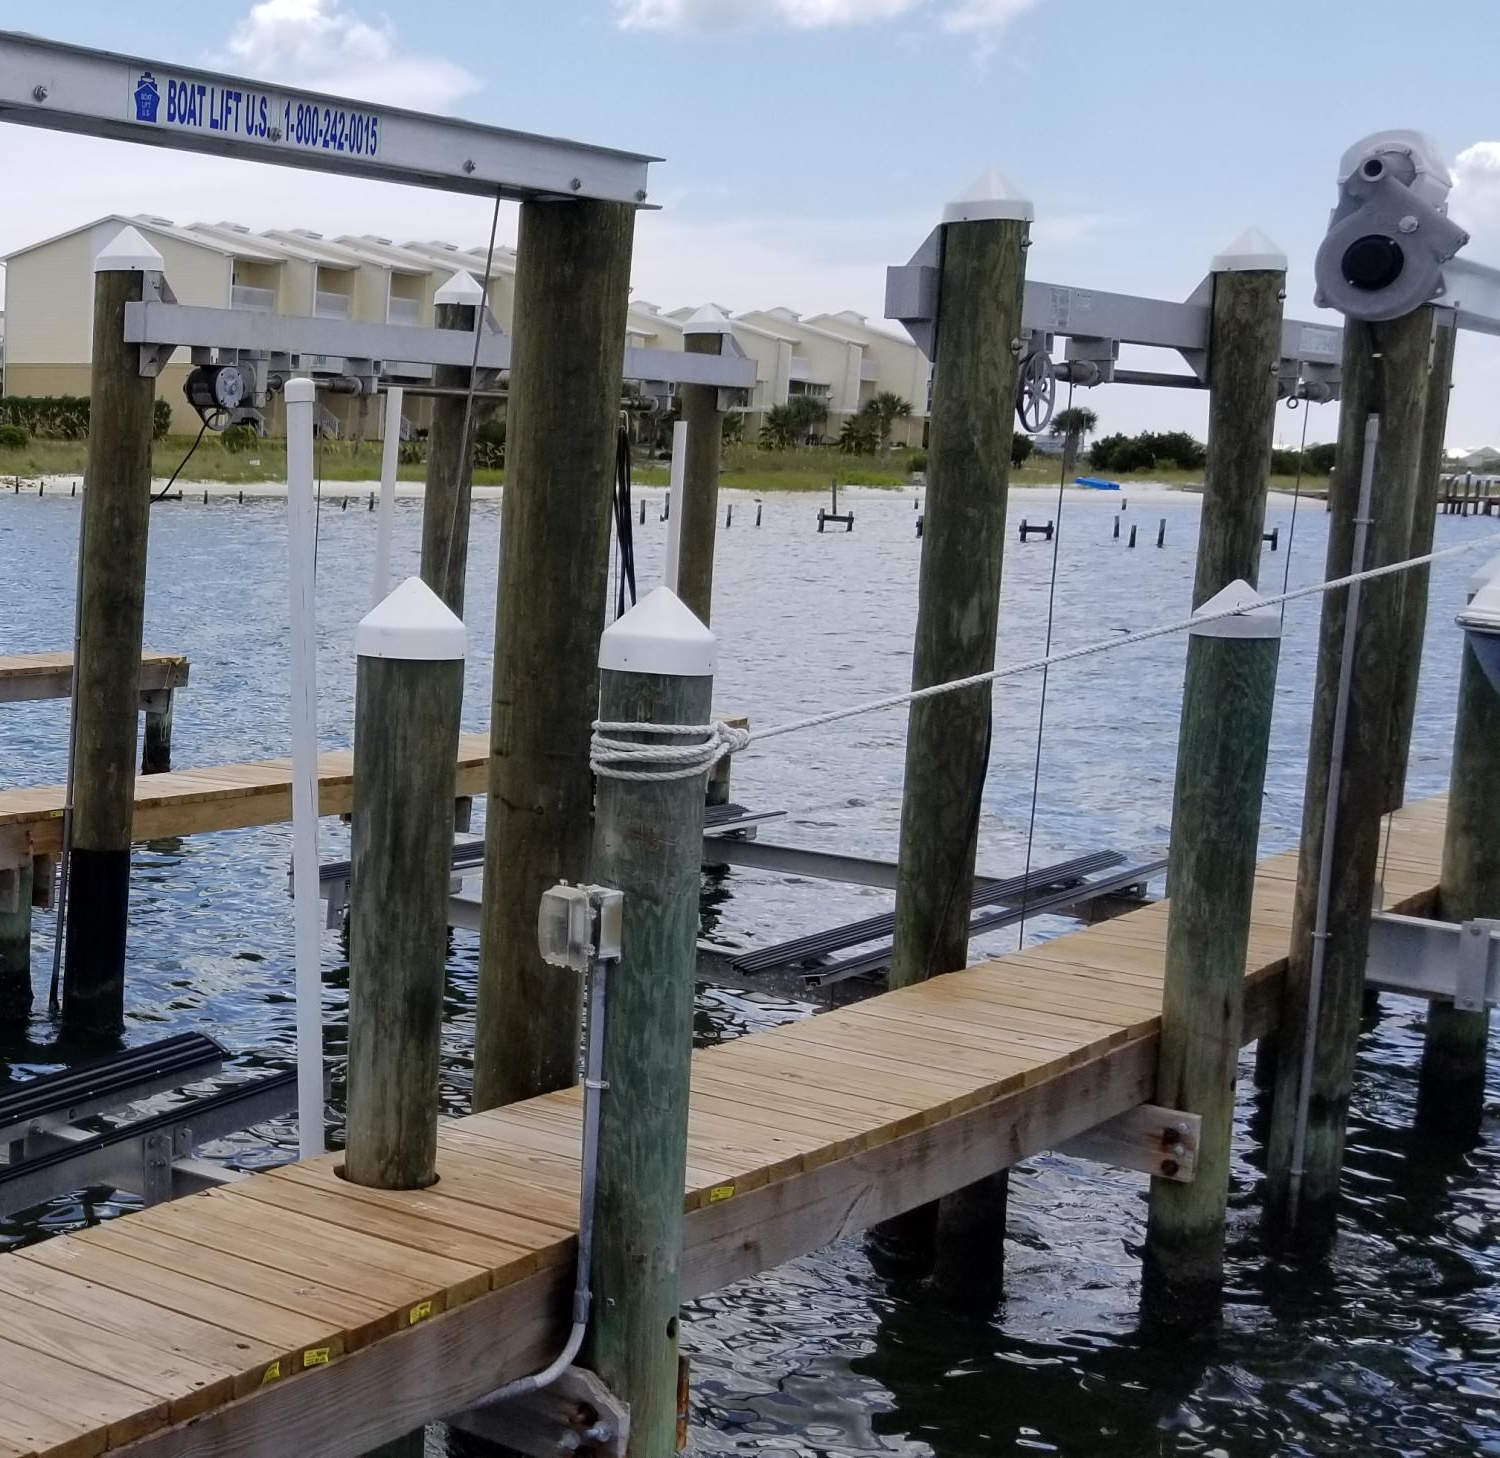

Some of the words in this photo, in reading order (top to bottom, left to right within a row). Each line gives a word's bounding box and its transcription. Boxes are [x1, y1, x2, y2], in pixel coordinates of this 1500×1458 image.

[167, 80, 206, 127] BOAT
[210, 87, 242, 132] LIFT
[246, 95, 271, 139] U.S.
[285, 101, 378, 156] 1-800-242-0015
